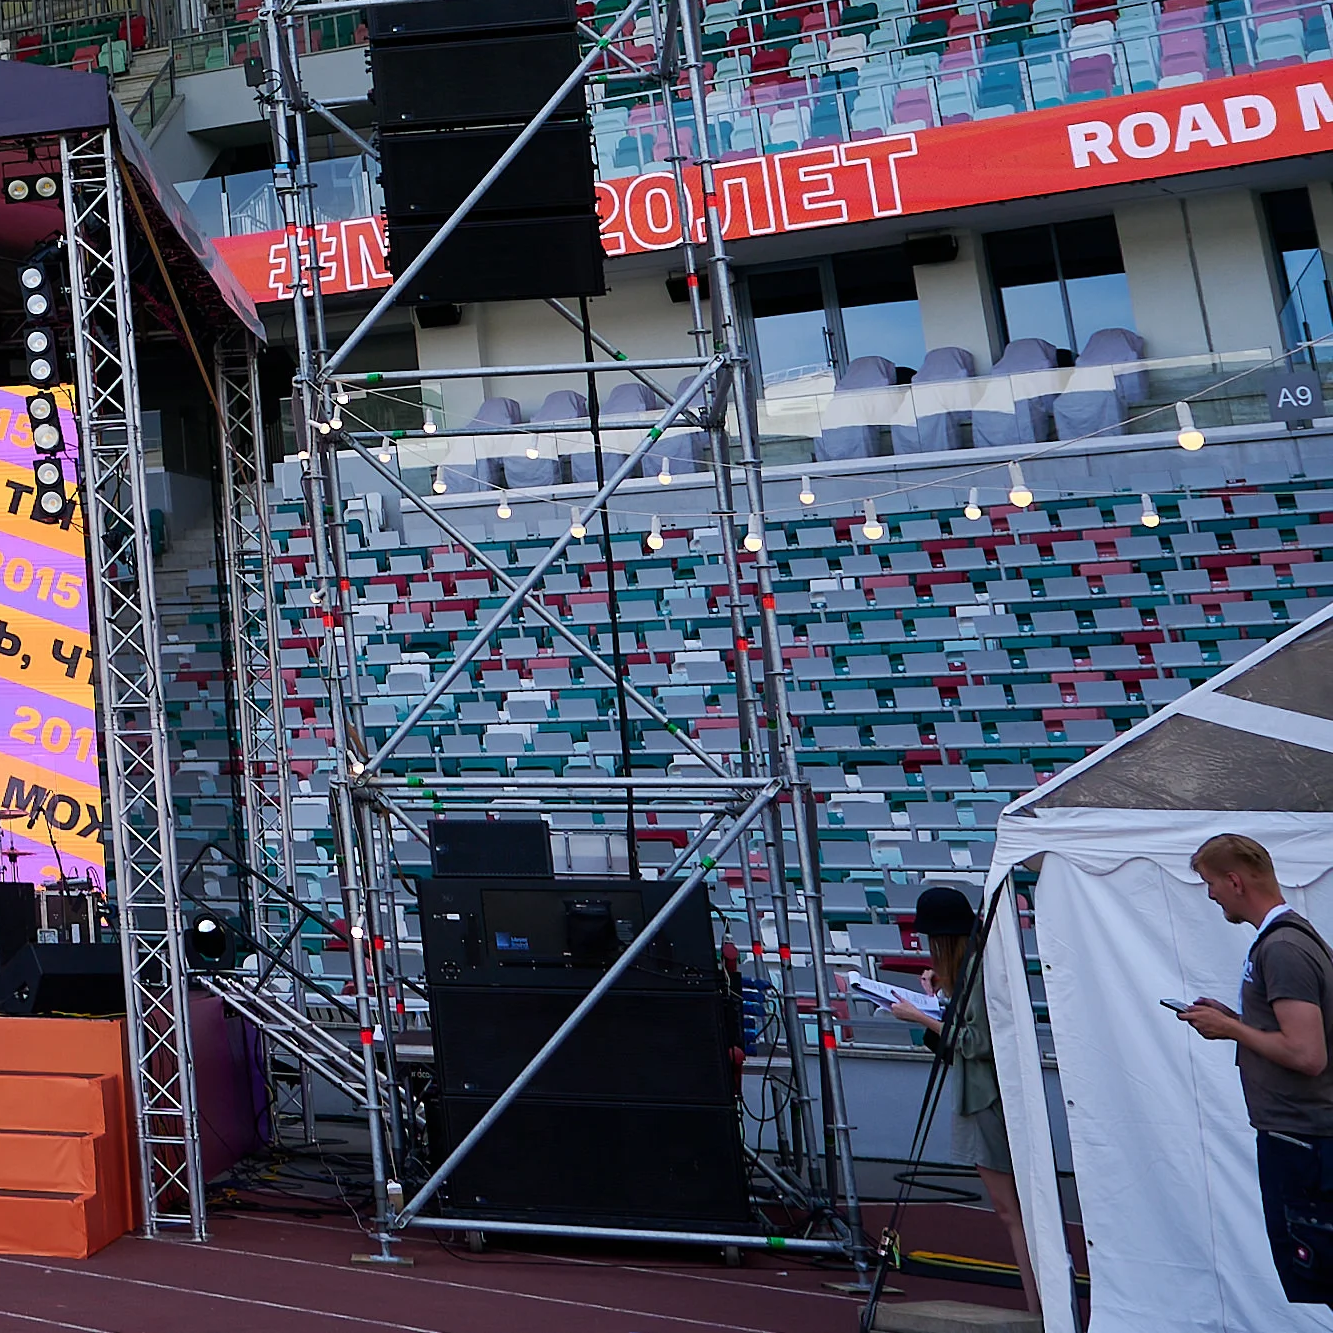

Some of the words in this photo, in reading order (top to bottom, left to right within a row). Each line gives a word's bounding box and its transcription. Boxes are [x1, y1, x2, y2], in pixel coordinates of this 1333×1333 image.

[1067, 94, 1277, 169] ROAD
[1278, 385, 1312, 408] A9
[9, 705, 97, 765] 201
